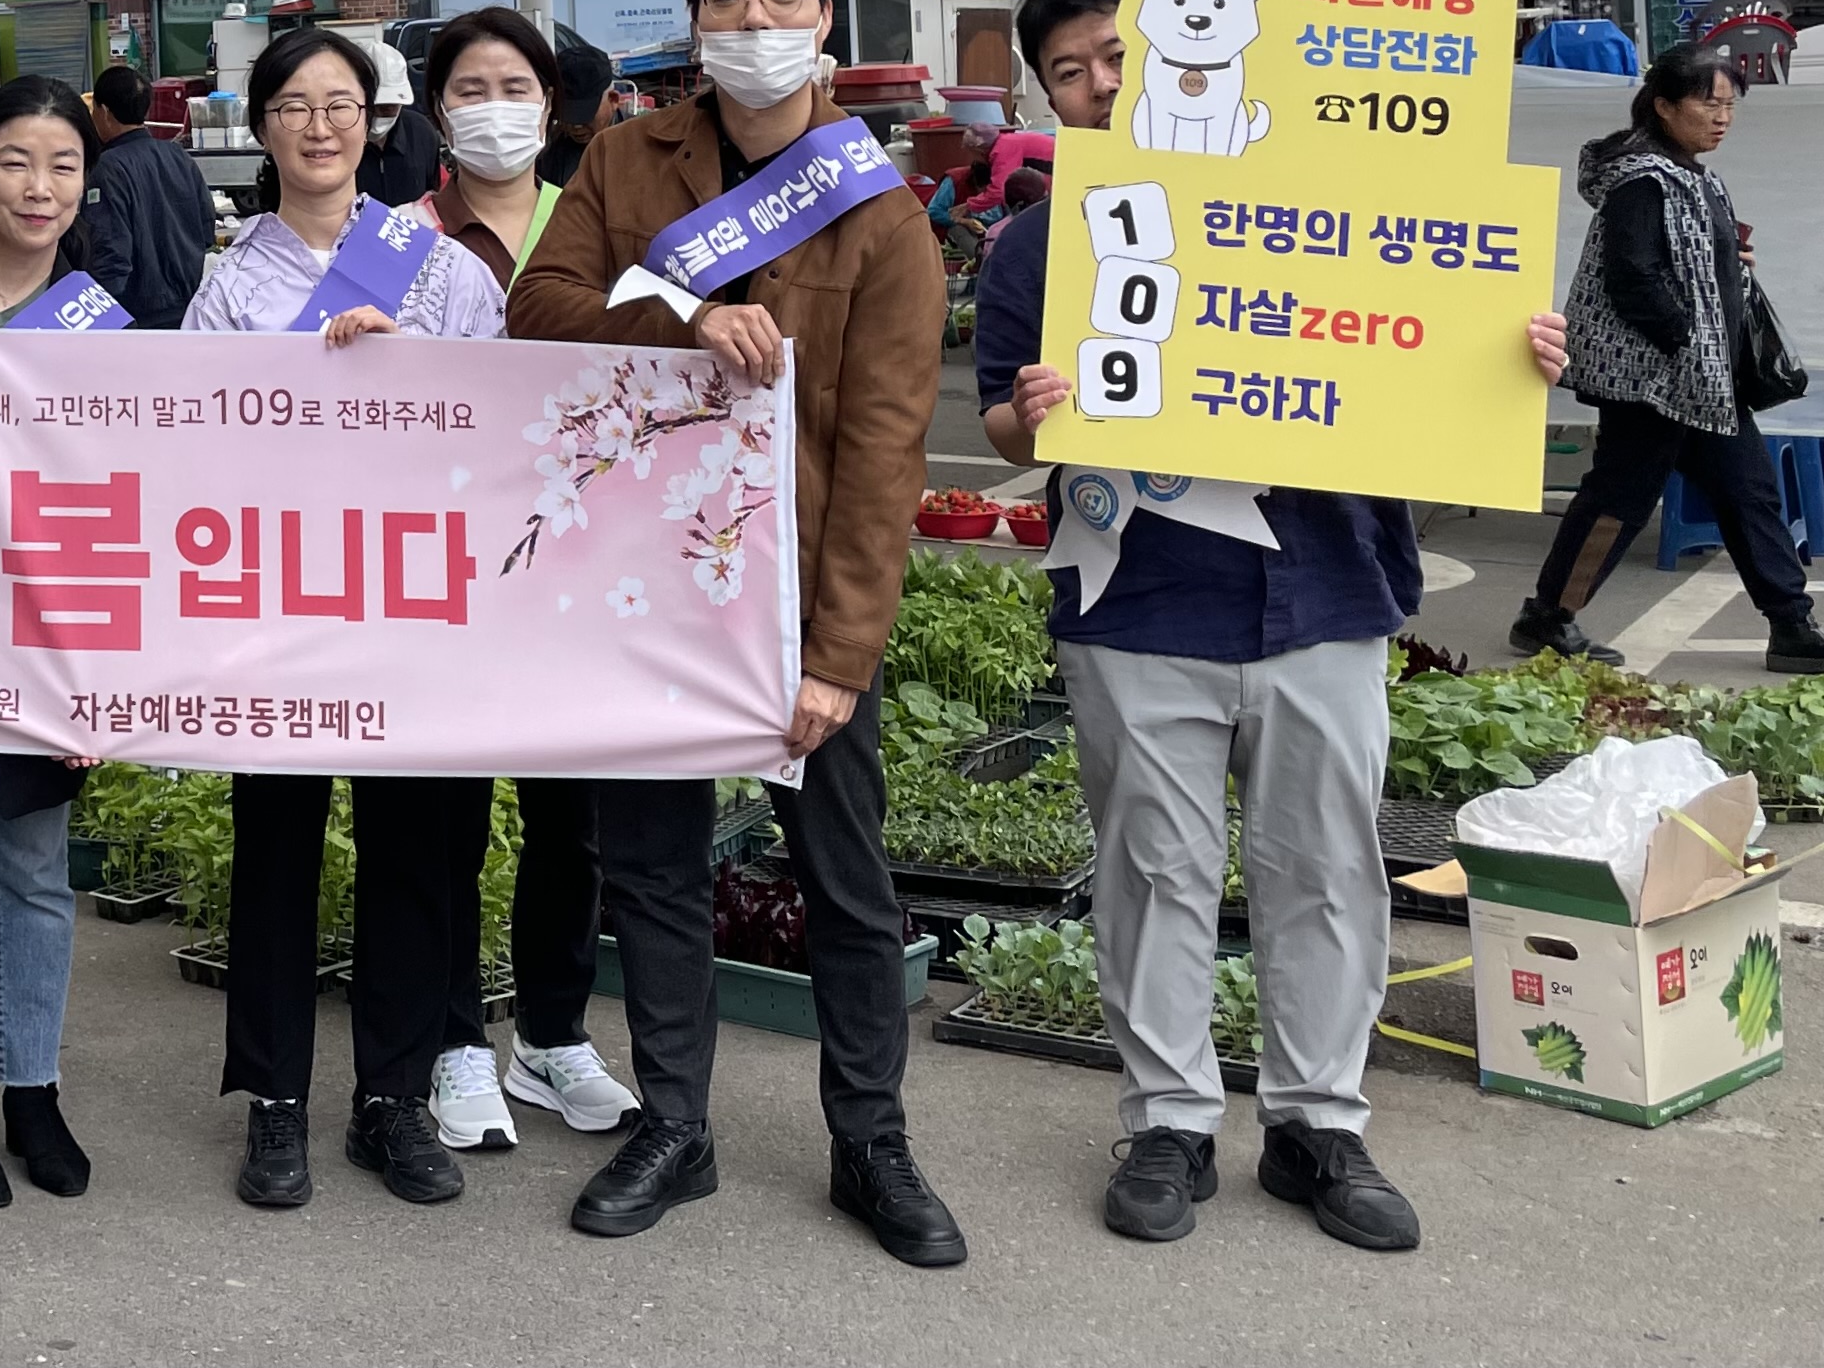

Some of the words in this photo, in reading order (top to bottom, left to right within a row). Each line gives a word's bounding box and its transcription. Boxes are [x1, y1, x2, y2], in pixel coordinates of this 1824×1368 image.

[1295, 22, 1477, 77] 상담전화
[748, 153, 845, 236] 순간을
[674, 215, 751, 279] 함께
[1202, 198, 1351, 259] 한명의
[1368, 214, 1520, 274] 생명도
[1194, 282, 1425, 350] 자살zero
[32, 394, 141, 428] 고민하지
[336, 397, 477, 432] 전화주세요
[1190, 367, 1342, 428] 구하자
[69, 692, 387, 741] 자살예방공동캠페인
[1690, 945, 1708, 970] 오이
[1551, 981, 1573, 996] 오이
